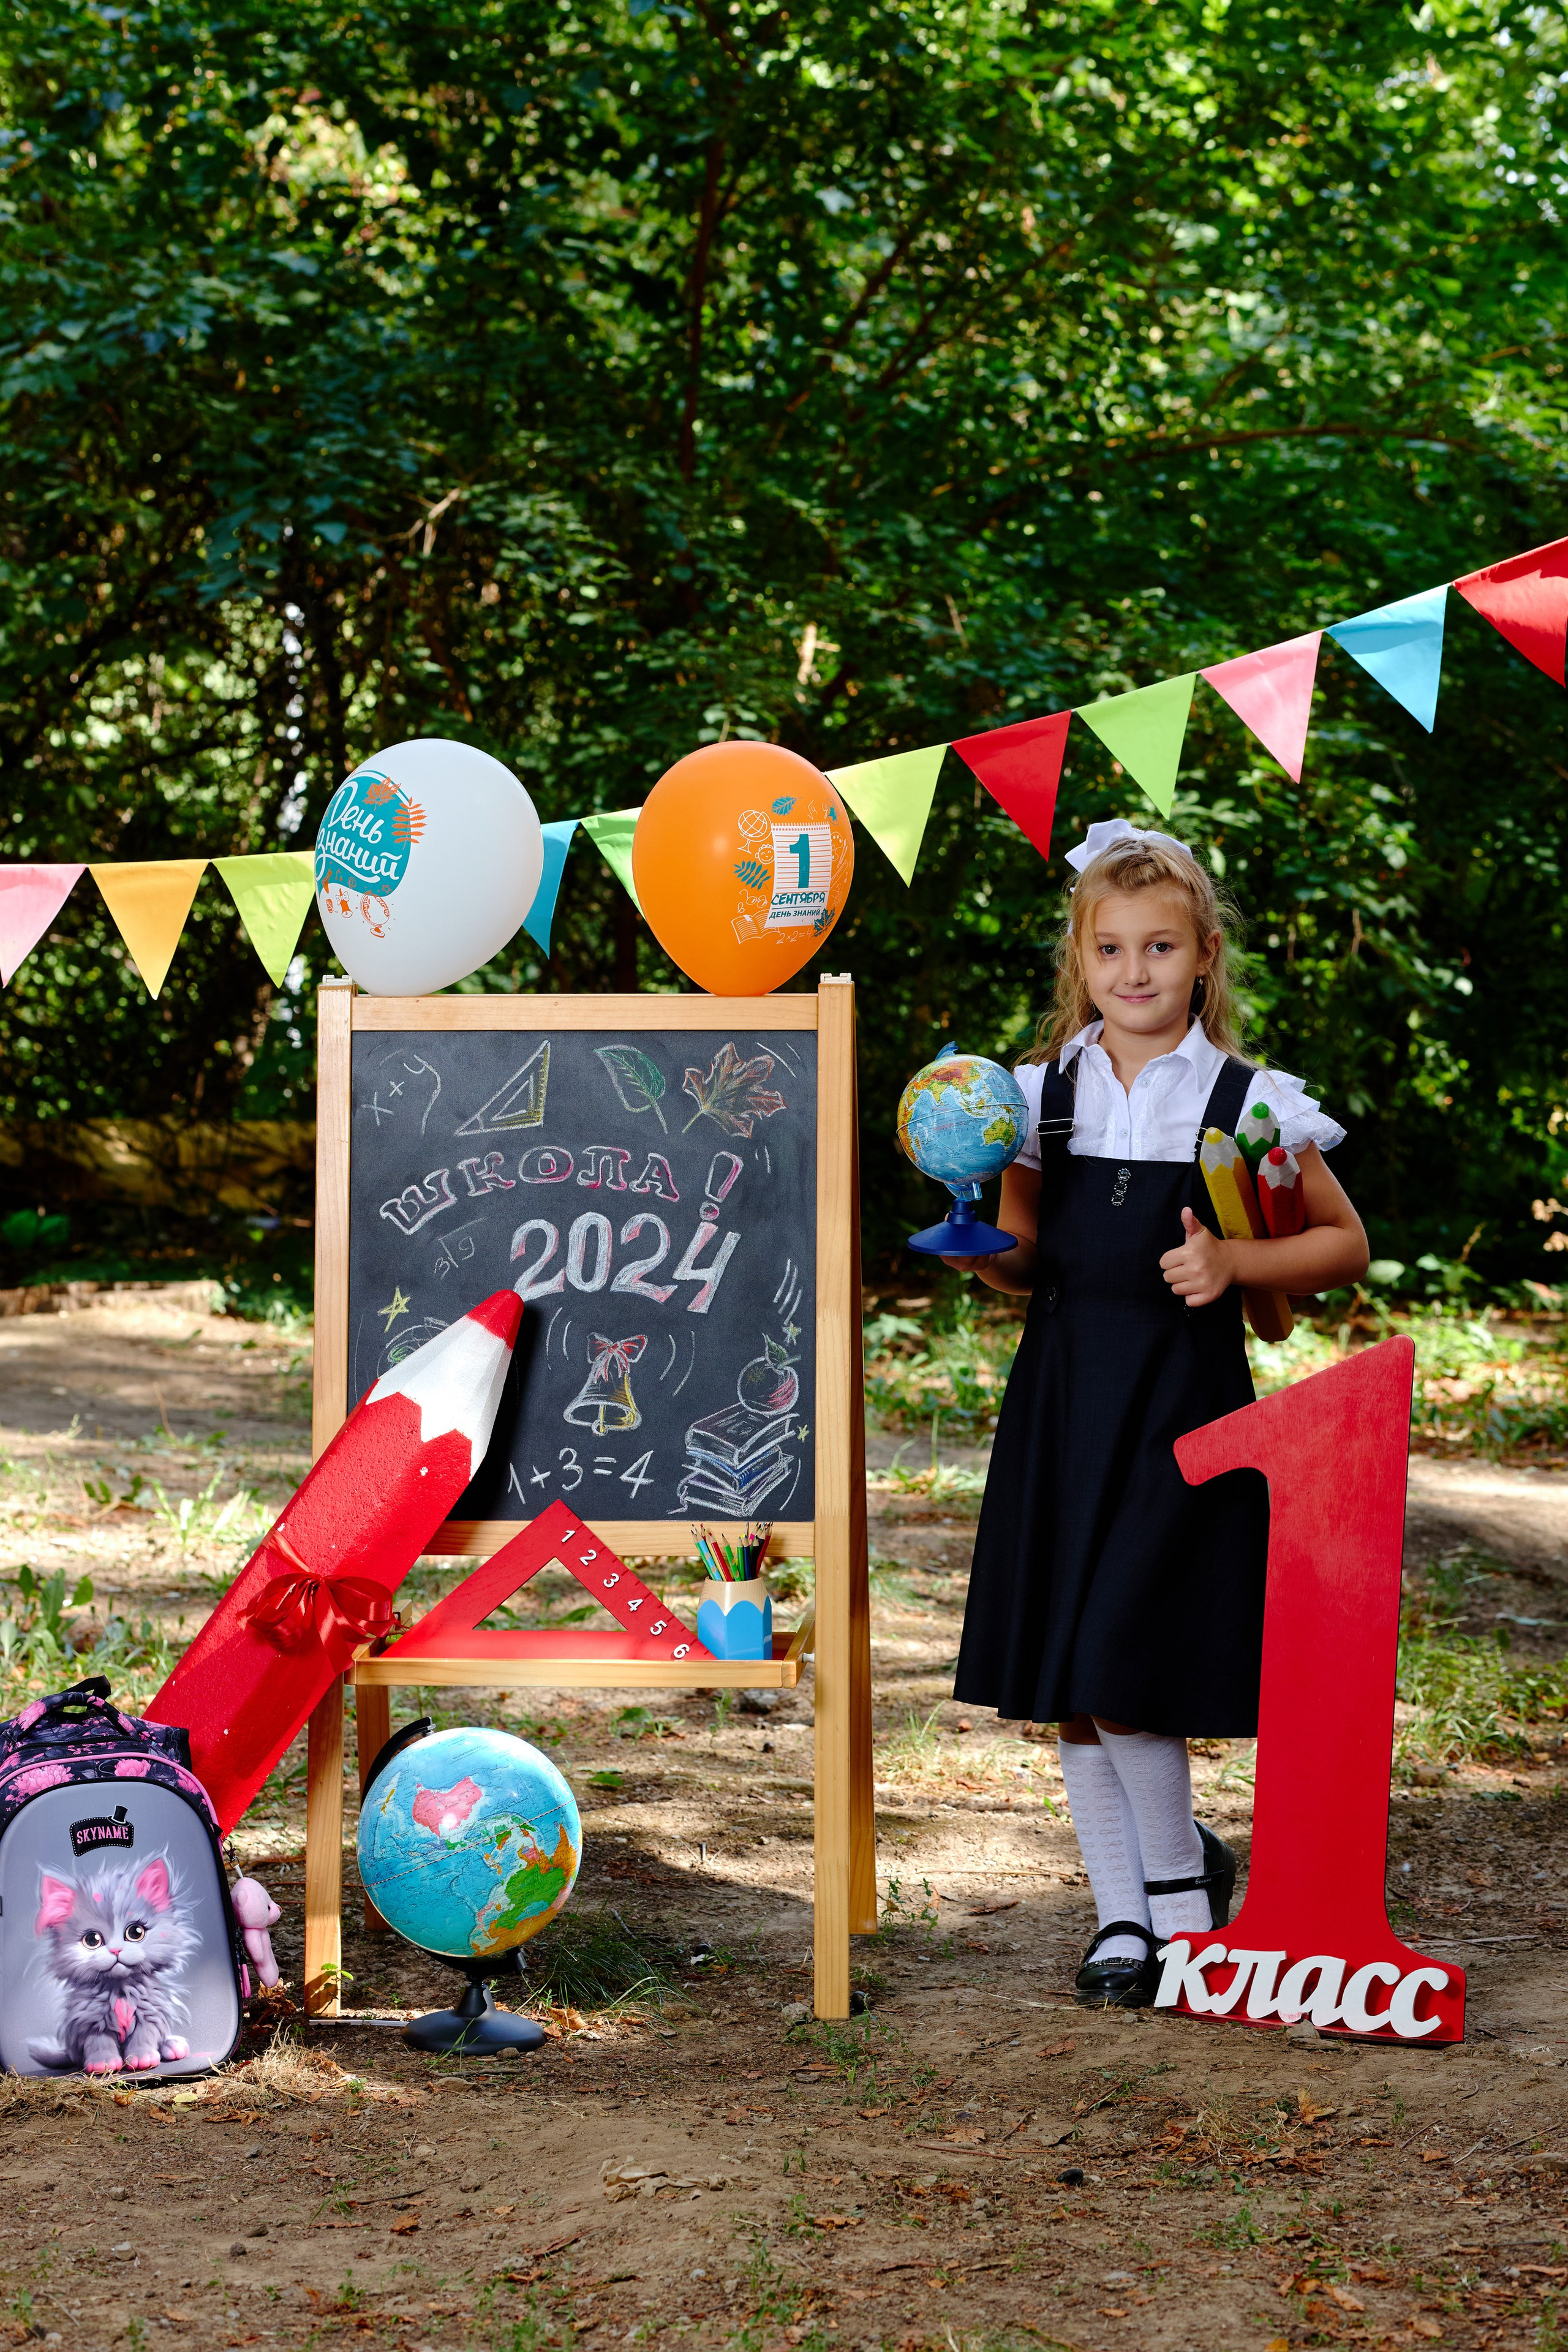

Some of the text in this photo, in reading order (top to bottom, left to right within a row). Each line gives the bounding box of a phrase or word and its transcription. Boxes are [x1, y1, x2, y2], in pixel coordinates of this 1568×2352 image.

[328, 781, 385, 844] День
[315, 827, 402, 883] знаний
[789, 834, 810, 889] 1
[768, 908, 821, 920] ДЕНЬ ЗНАНИЙ
[771, 891, 826, 905] СЕНТЯБРЯ
[510, 1210, 742, 1315] 2024
[561, 1529, 690, 1659] 1 2 3 4 5 6
[1172, 1334, 1439, 1985] 1
[76, 1826, 129, 1844] SKYNAME
